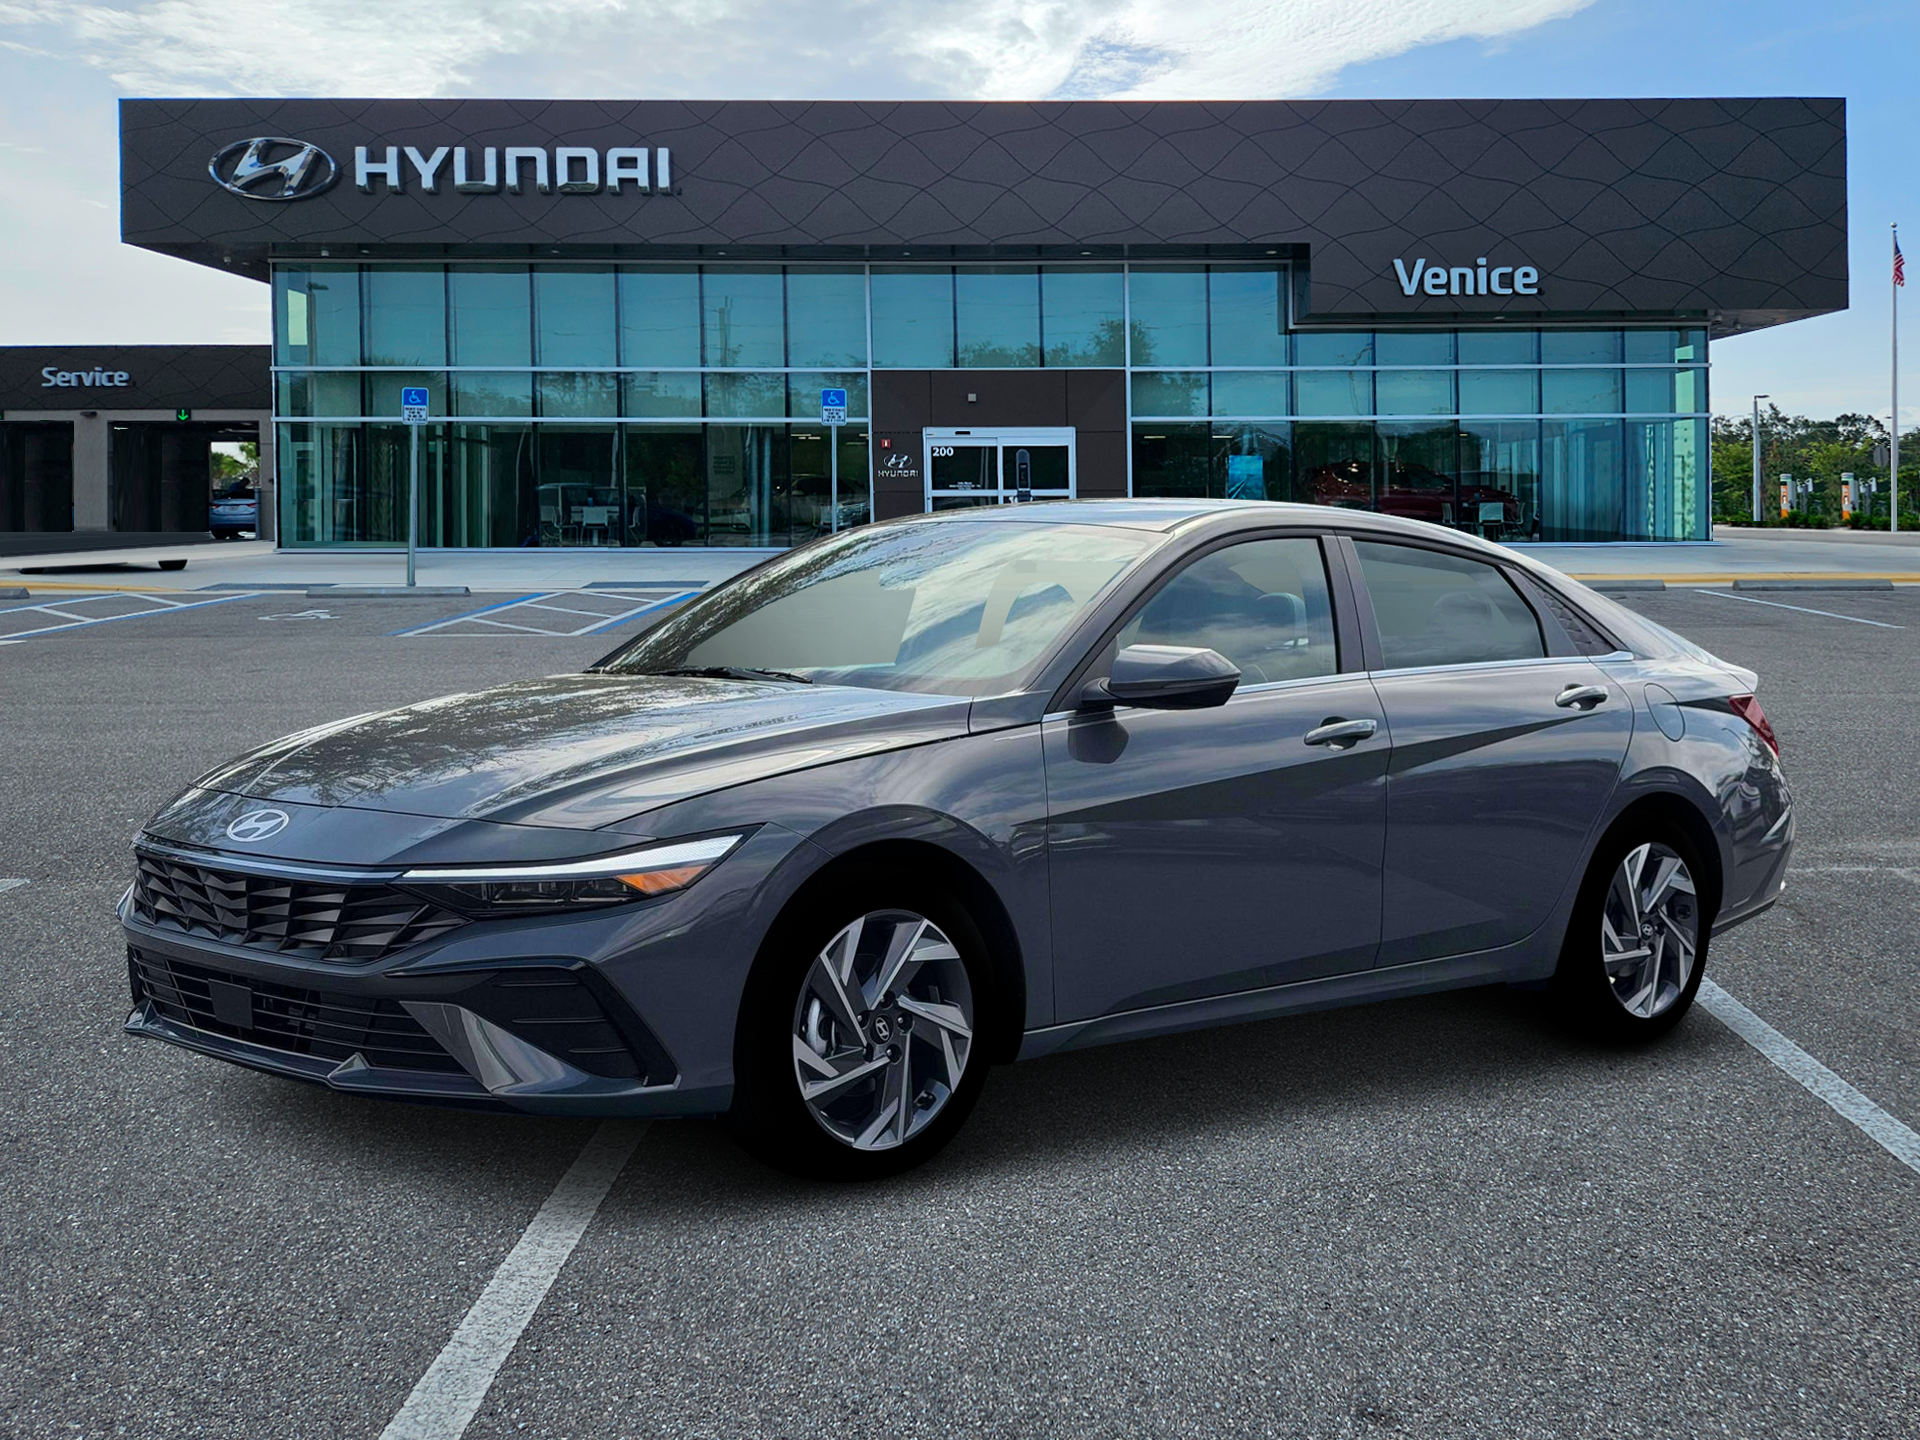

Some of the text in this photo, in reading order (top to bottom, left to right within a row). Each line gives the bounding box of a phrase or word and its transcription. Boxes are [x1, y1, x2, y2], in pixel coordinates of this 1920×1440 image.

[354, 146, 670, 193] HYUNDAI
[1393, 257, 1539, 296] Venice
[41, 366, 130, 388] Service
[932, 446, 954, 457] 200
